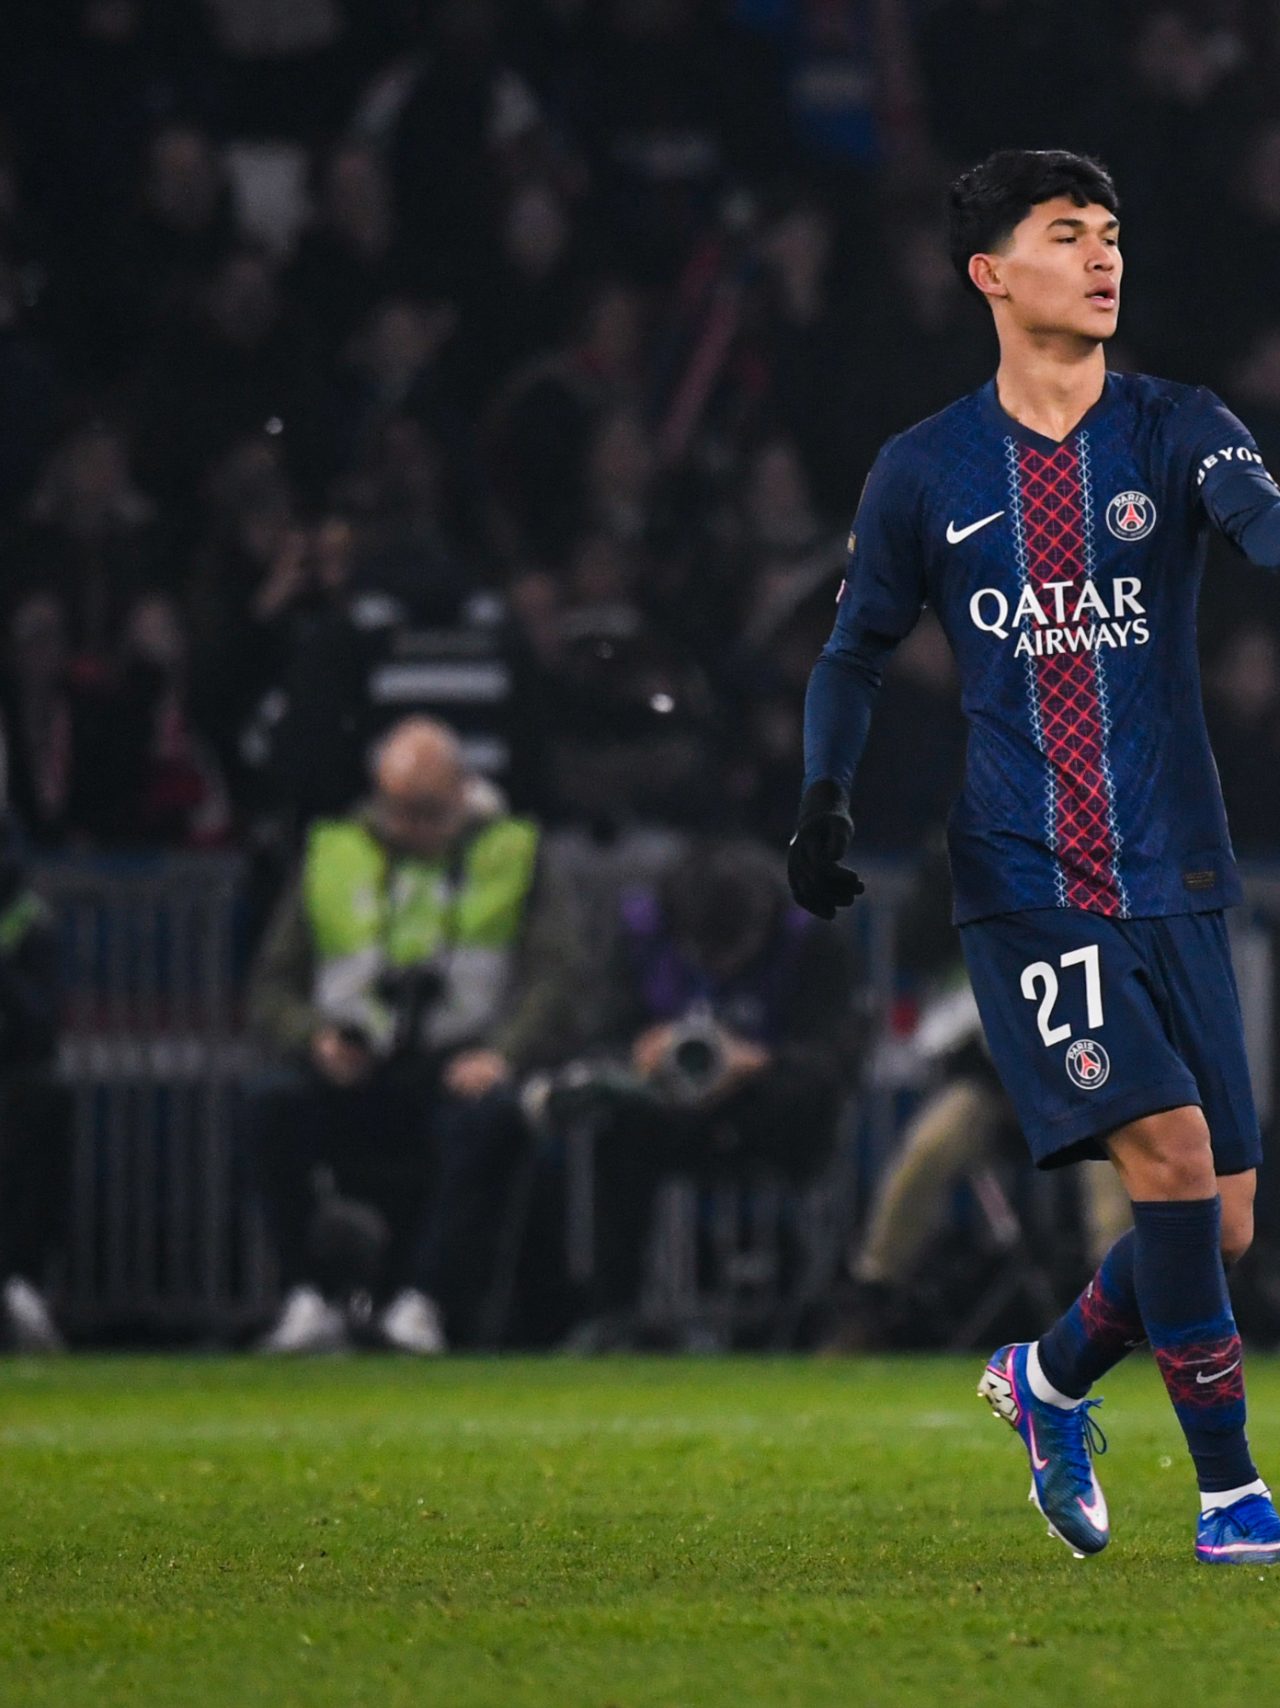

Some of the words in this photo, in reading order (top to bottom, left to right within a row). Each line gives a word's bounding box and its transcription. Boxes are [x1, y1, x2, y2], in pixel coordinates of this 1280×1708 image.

[1113, 493, 1147, 508] PARIS
[969, 576, 1147, 640] QATAR
[1013, 618, 1151, 659] AIRWAYS
[1020, 944, 1104, 1048] 27
[1068, 1042, 1095, 1061] PARIS
